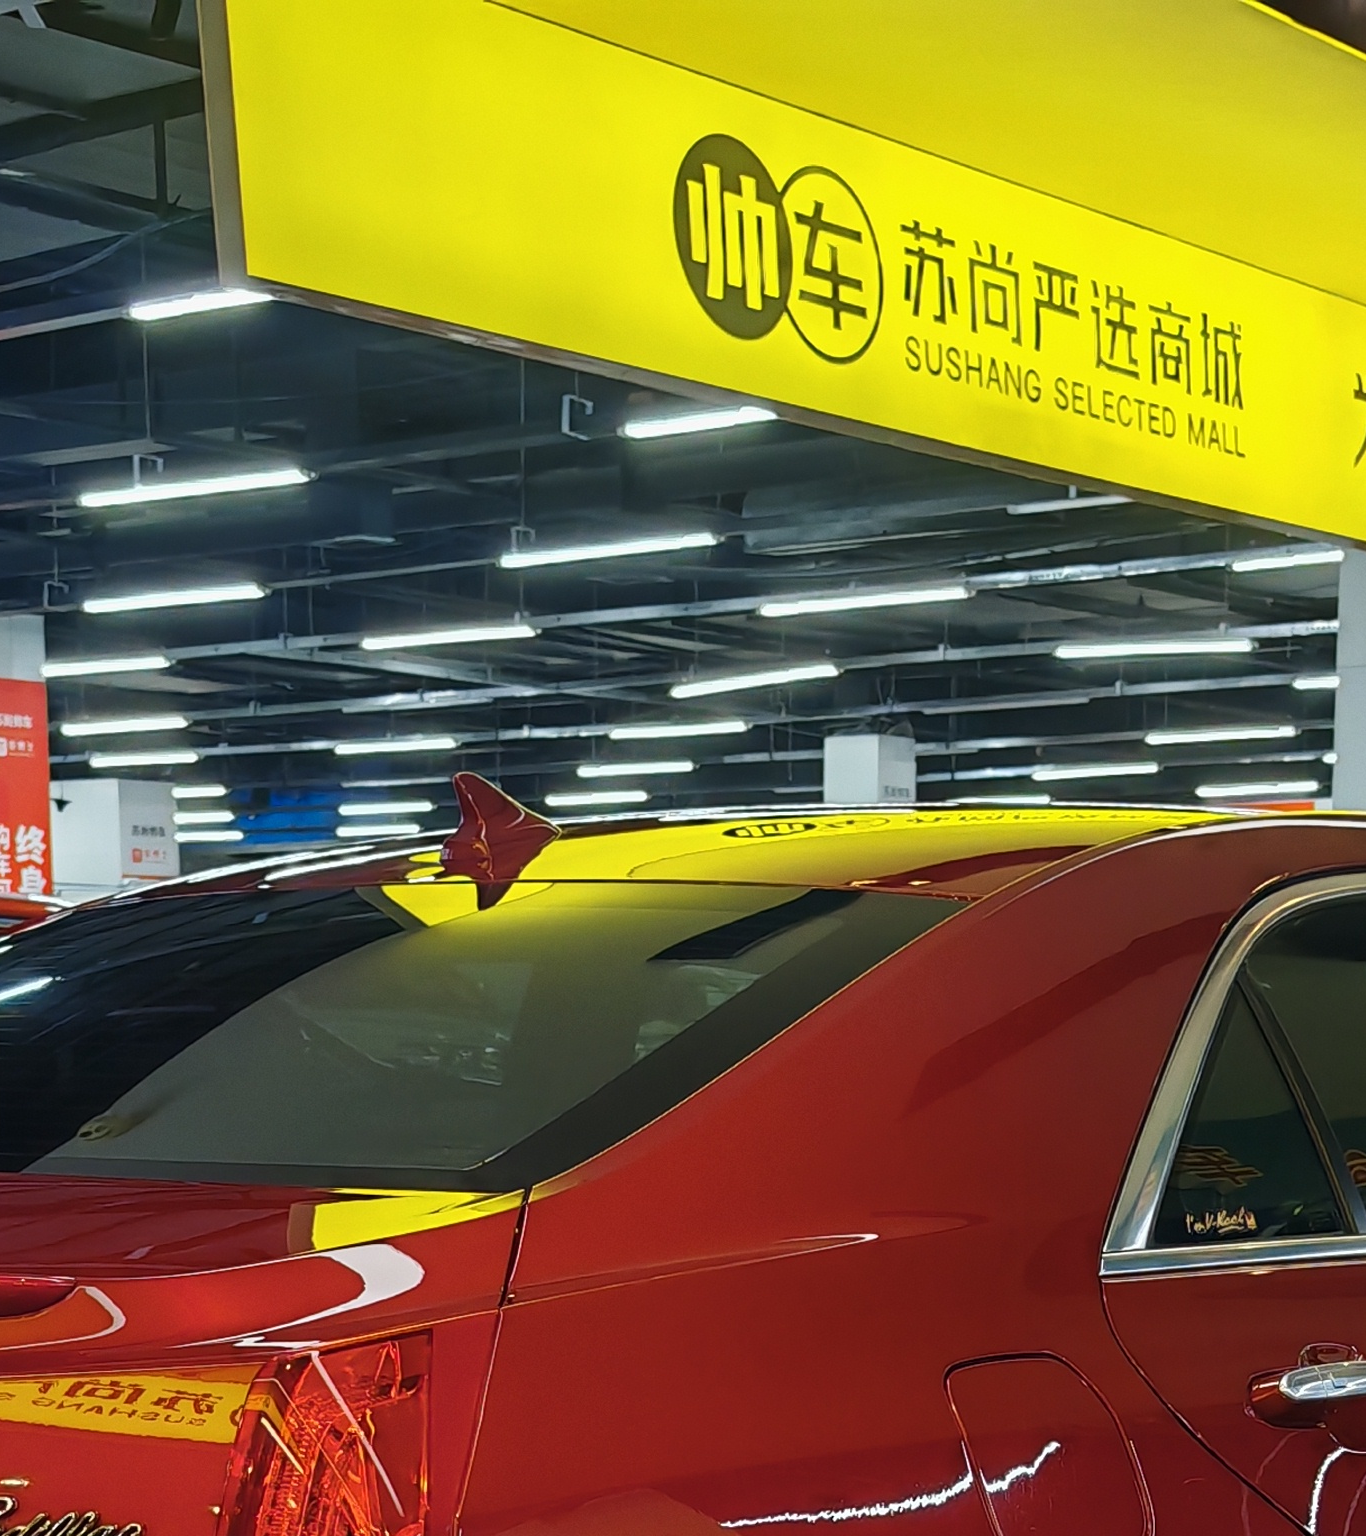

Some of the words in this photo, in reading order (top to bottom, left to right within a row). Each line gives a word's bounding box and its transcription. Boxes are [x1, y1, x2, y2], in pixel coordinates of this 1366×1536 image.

[899, 219, 1245, 411] 苏尚严选商城
[903, 336, 1043, 403] SUSHANG
[1053, 376, 1177, 440] SELECTED
[1187, 412, 1246, 459] MALL
